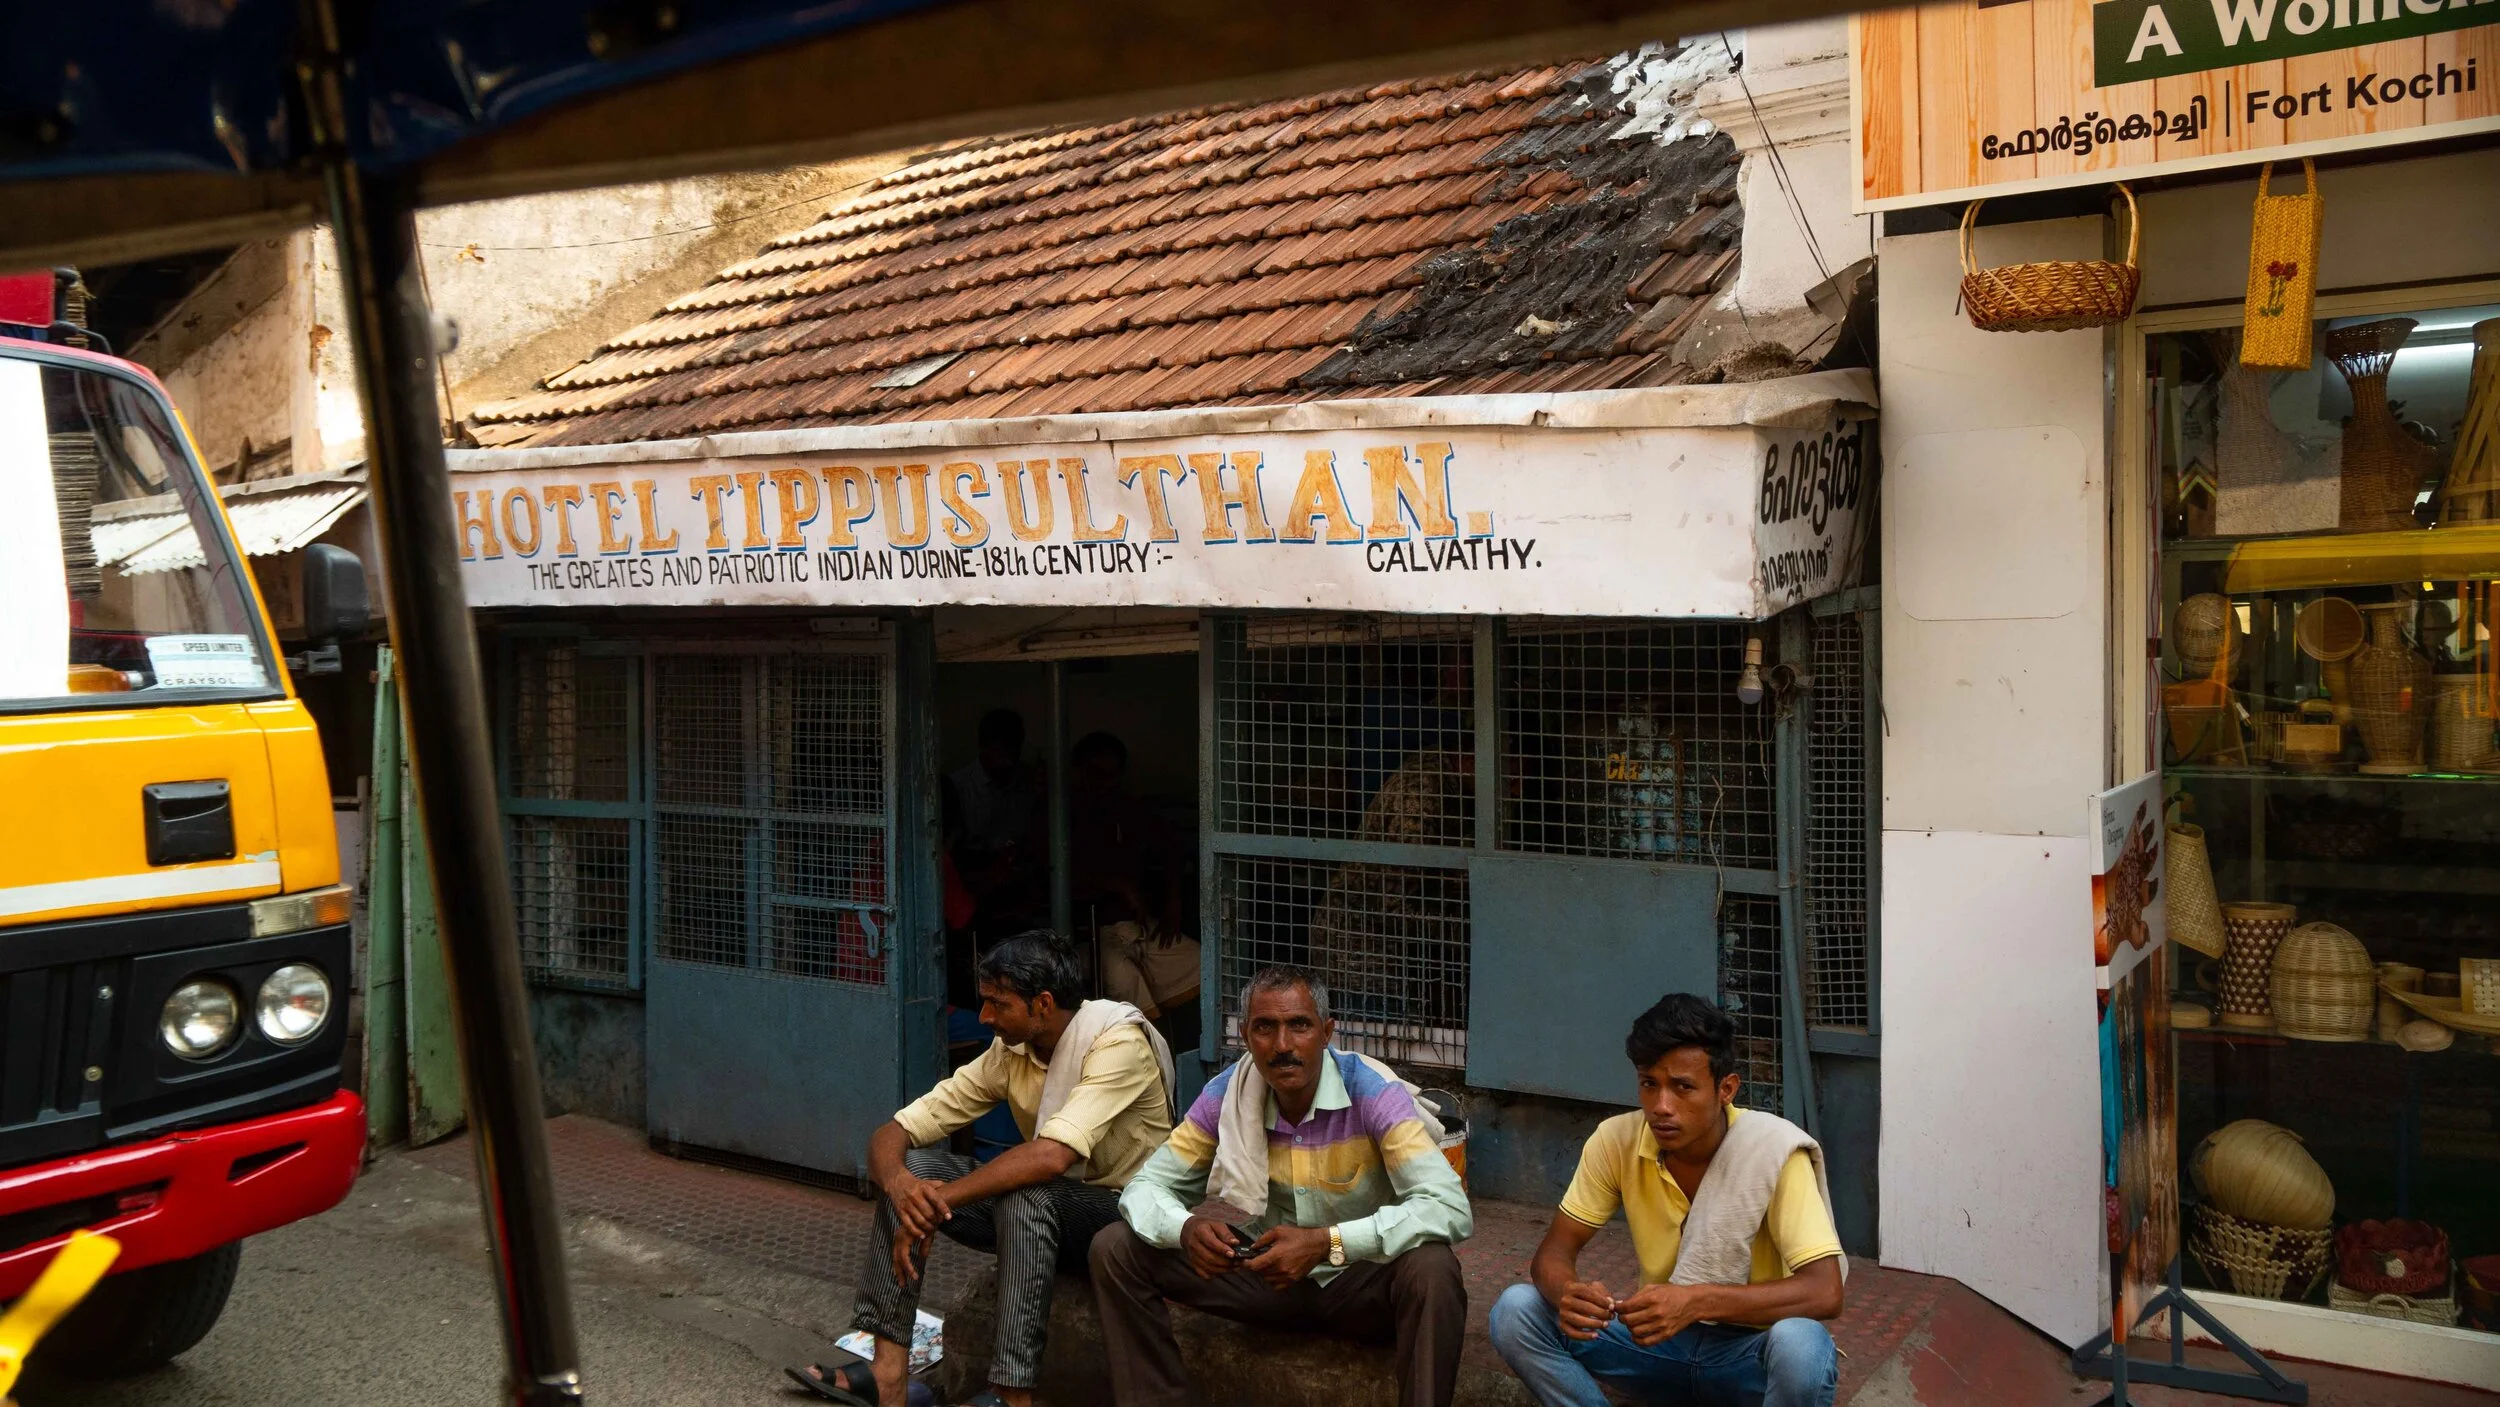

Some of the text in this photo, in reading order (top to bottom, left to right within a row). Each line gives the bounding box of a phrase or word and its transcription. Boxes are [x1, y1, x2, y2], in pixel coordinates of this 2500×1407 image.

[2125, 0, 2496, 63] A Wom
[2246, 58, 2477, 124] Fort Kochi
[453, 479, 680, 561] HOTEL
[528, 563, 565, 591] THE
[567, 558, 654, 590] GREATES
[662, 556, 702, 587] AND
[709, 551, 810, 586] PATRIOTIC
[817, 548, 893, 582] INDIAN
[1366, 537, 1542, 573] CALVATHY.
[182, 642, 210, 653] SPEED
